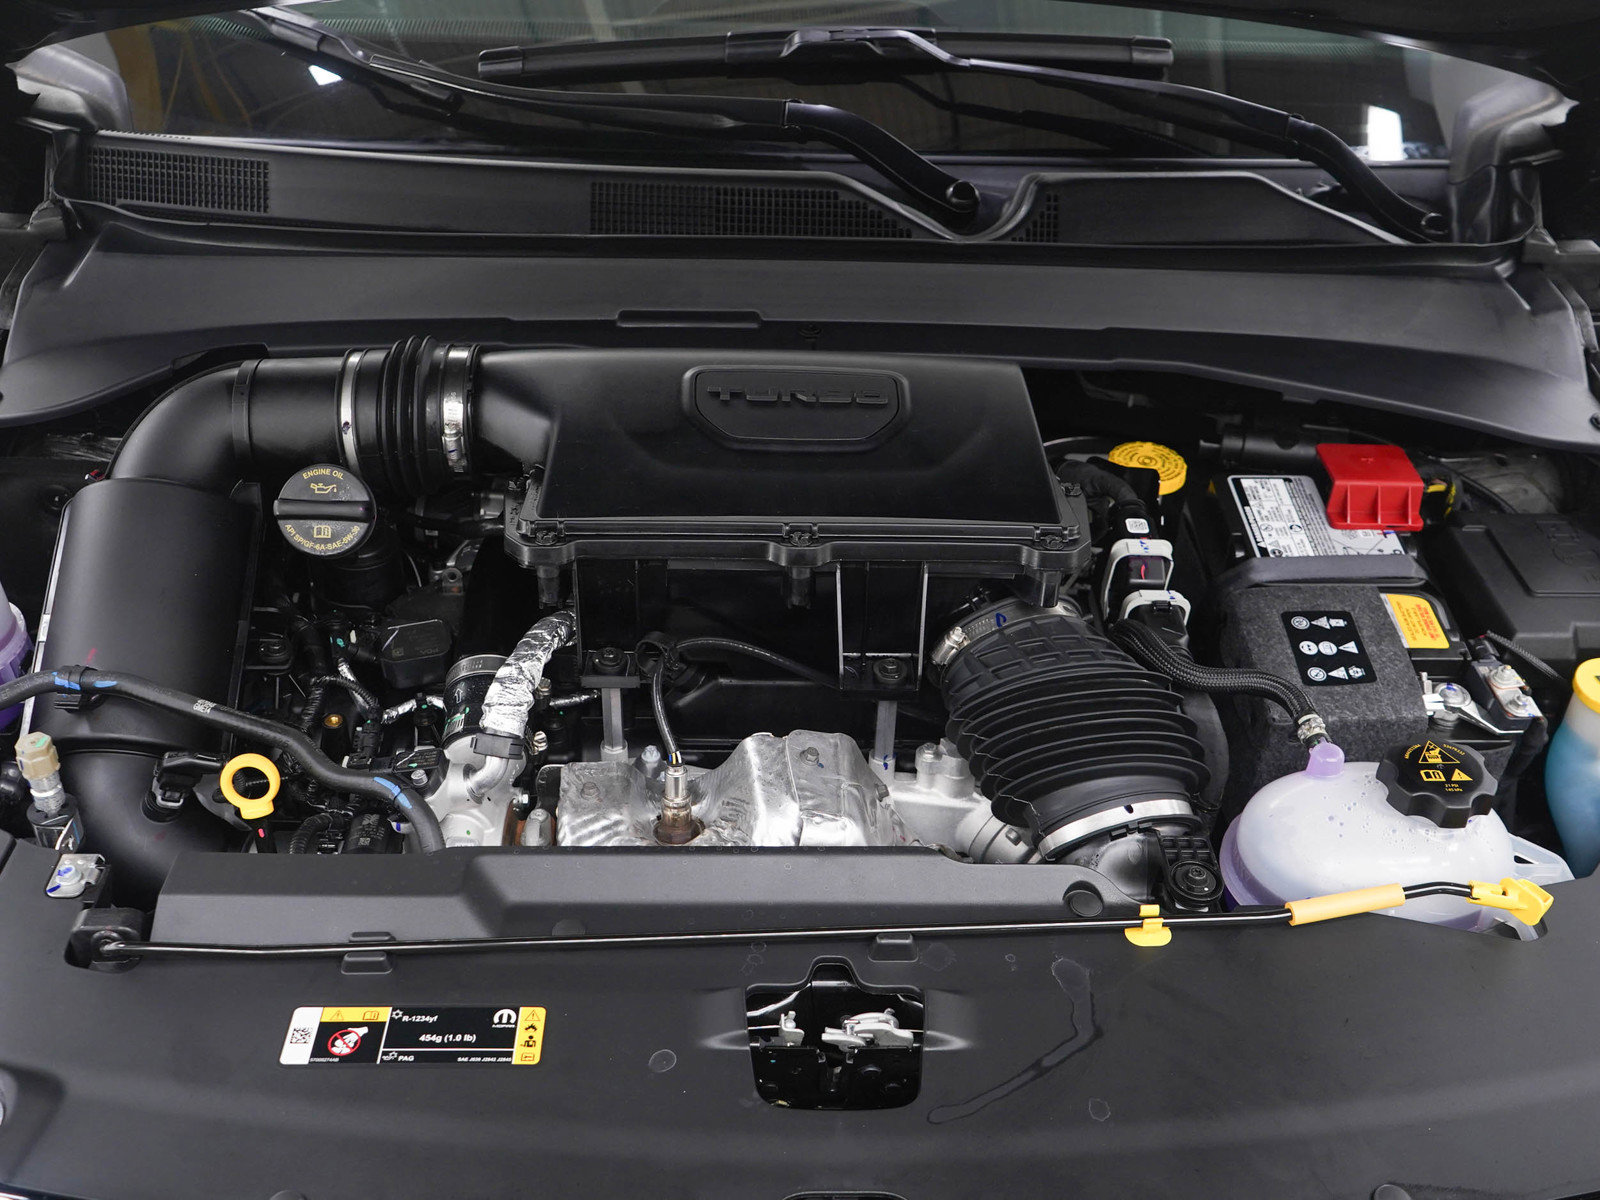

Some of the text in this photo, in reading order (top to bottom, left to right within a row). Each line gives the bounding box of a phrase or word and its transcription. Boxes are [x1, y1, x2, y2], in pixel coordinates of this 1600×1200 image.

[707, 385, 889, 404] TURBO
[302, 468, 344, 480] ENGINE OIL
[285, 524, 296, 536] API
[401, 1015, 438, 1024] R-1234yf
[418, 1034, 477, 1044] 454g (1.0 lb)
